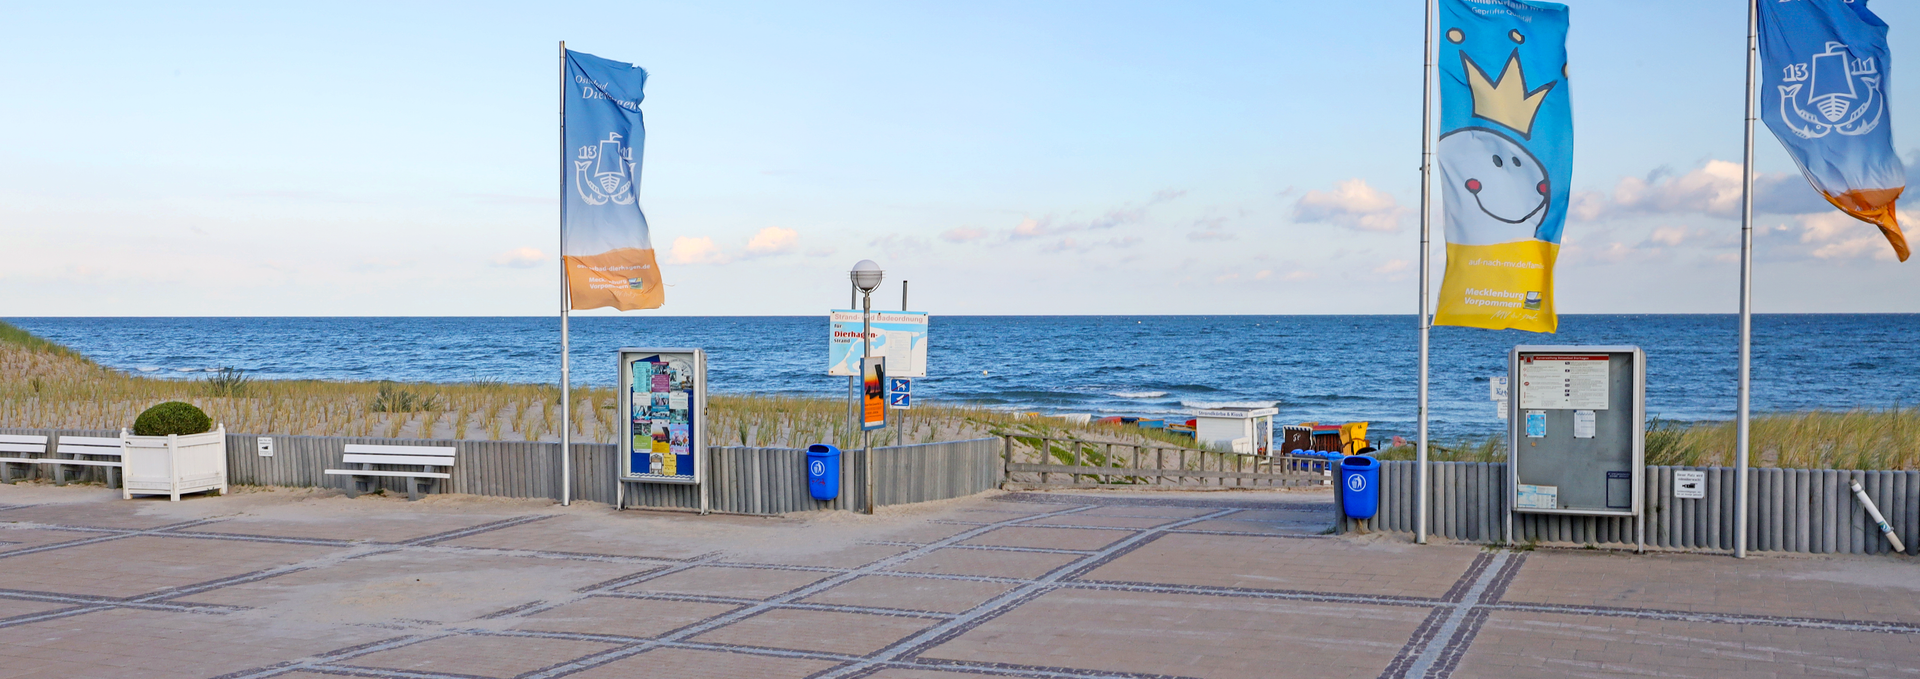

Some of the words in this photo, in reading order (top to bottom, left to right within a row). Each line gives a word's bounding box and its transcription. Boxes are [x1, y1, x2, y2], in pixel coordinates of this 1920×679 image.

[1782, 62, 1809, 82] 13
[1850, 56, 1878, 76] 11
[575, 74, 609, 90] Ostbad
[582, 86, 637, 110] Diergen
[577, 145, 597, 160] 13
[1465, 287, 1525, 301] Mecklenburg
[1464, 297, 1523, 308] Vorpommern
[876, 314, 923, 324] Badeordnung
[834, 331, 878, 340] Dierhagn-
